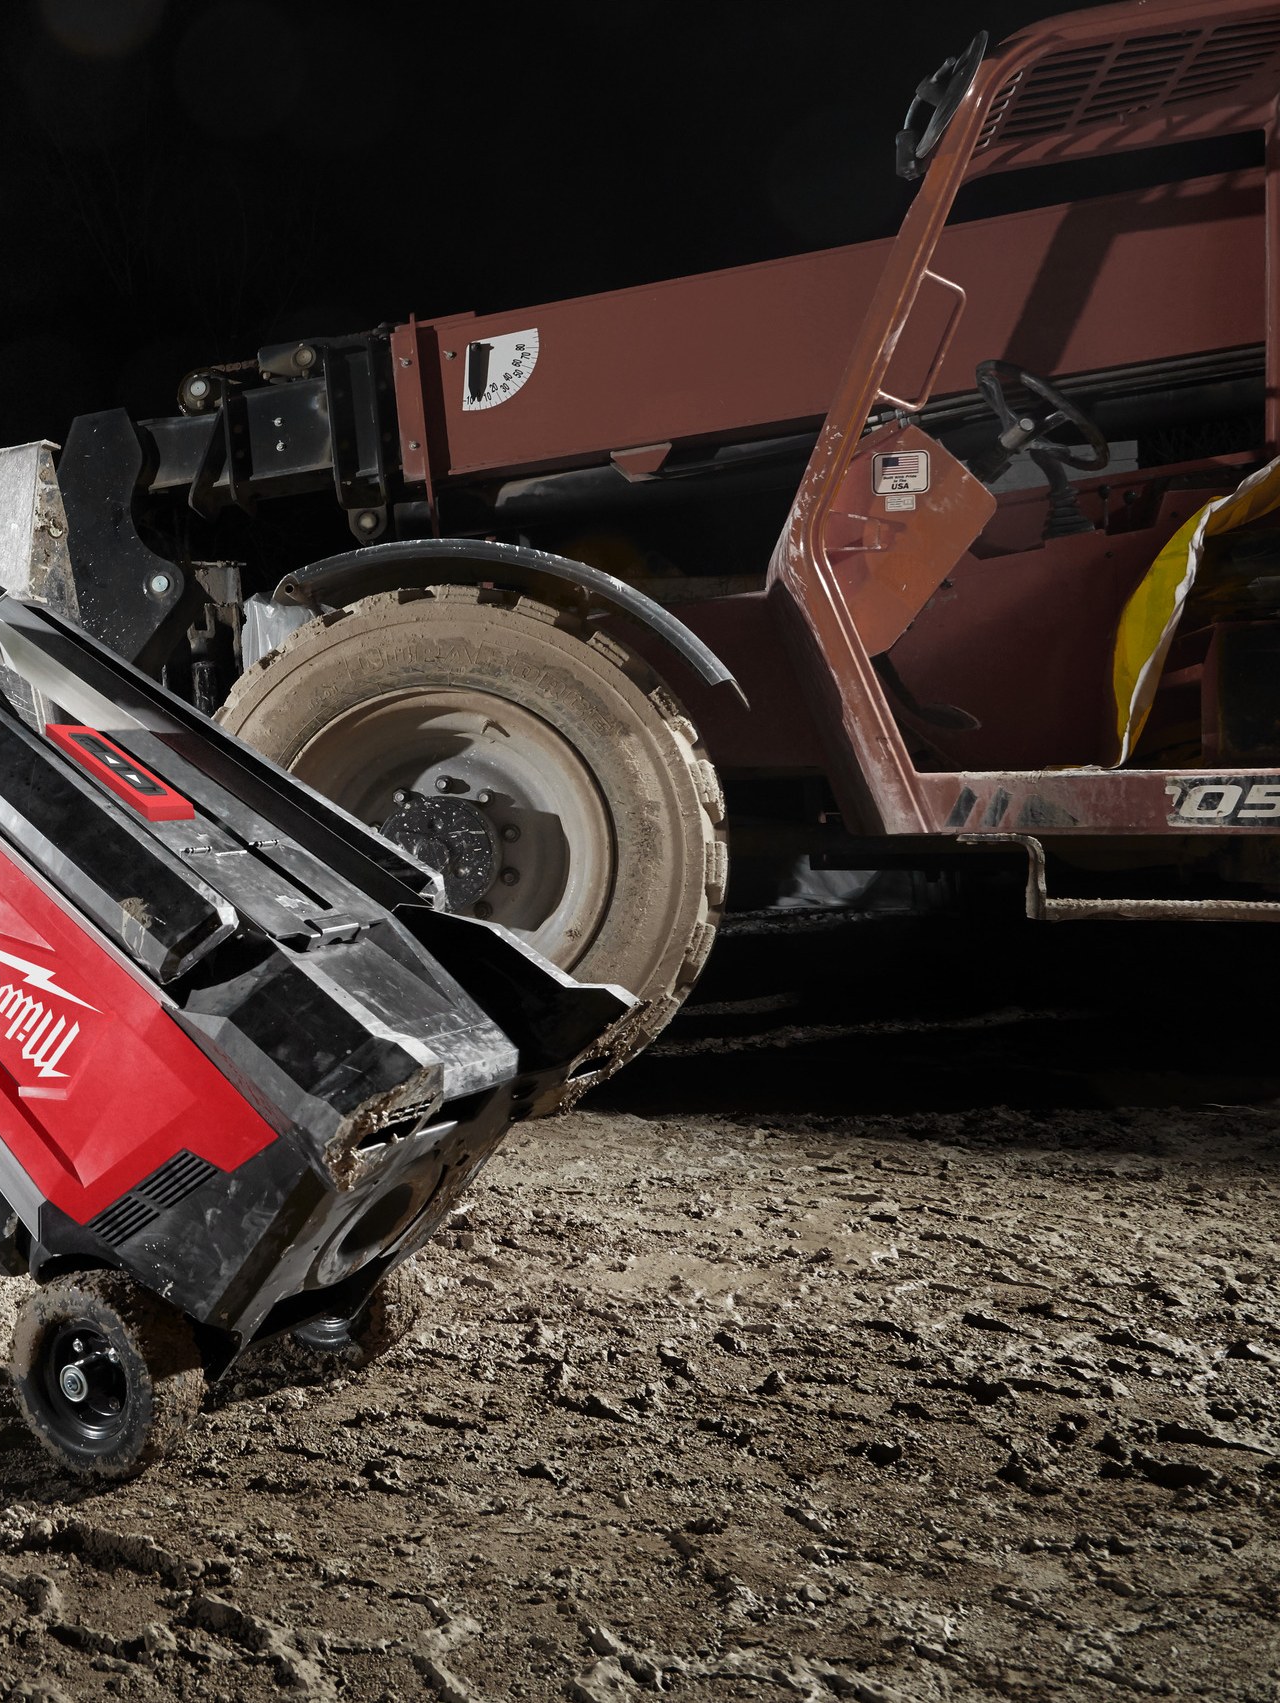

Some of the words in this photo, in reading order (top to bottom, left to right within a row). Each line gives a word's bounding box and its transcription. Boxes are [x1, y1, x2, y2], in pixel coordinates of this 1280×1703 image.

[520, 352, 531, 360] 70
[512, 359, 522, 367] 60
[503, 372, 512, 381] 40
[513, 369, 523, 378] 50
[489, 382, 498, 393] 20
[500, 382, 510, 393] 30
[483, 391, 492, 402] 10
